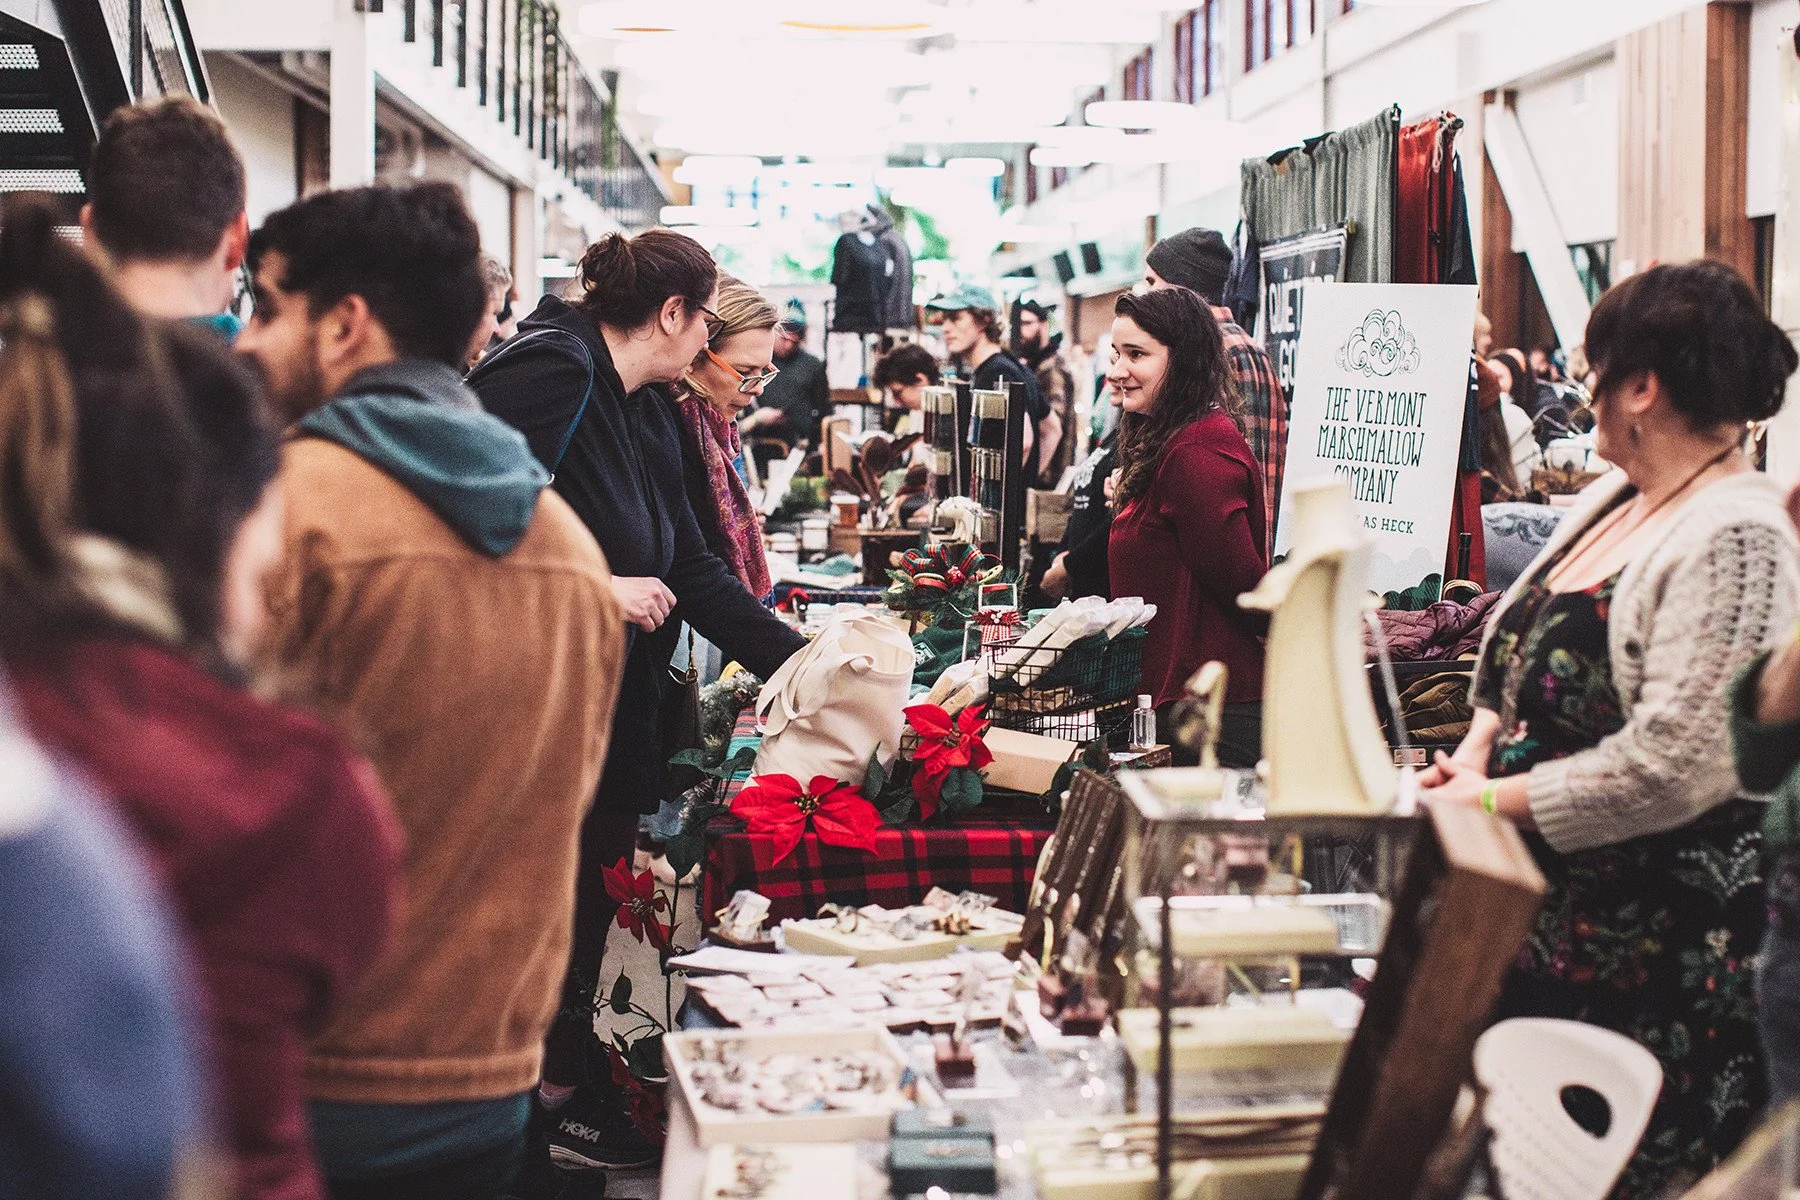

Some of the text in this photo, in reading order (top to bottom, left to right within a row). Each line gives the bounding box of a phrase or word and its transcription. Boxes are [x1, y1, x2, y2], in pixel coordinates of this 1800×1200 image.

[1325, 386, 1427, 428] THE VERMONT
[1316, 424, 1425, 468] MARSHMALLOW
[1363, 515, 1377, 529] AS
[1381, 518, 1414, 534] HECK
[559, 1117, 601, 1143] HOKA
